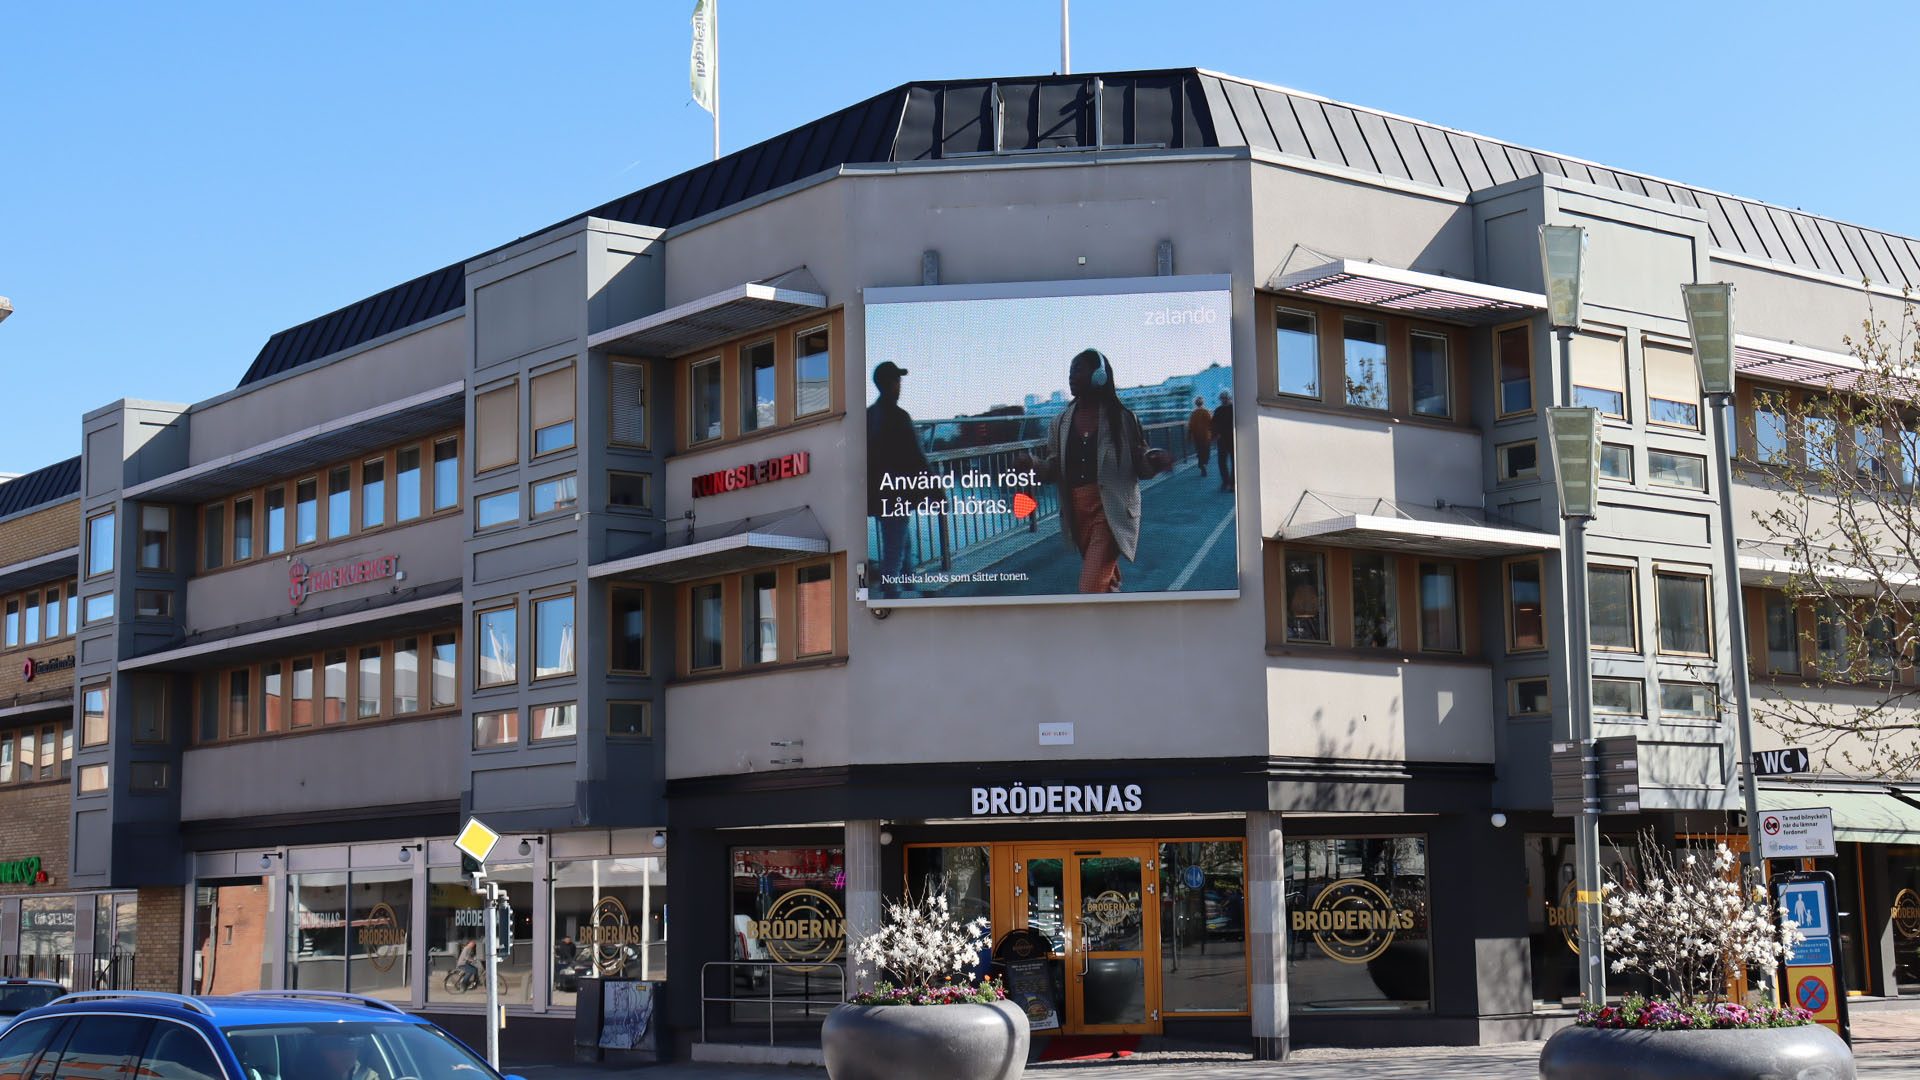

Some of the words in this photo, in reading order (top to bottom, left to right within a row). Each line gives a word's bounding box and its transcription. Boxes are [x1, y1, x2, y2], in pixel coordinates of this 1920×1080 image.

[1144, 307, 1217, 326] zalando
[692, 451, 810, 498] KUNGSLEDEN
[879, 471, 954, 490] Använd
[961, 470, 991, 489] din
[998, 469, 1041, 488] röst.
[881, 497, 912, 517] Låt
[917, 496, 948, 517] det
[952, 494, 1012, 516] höras.
[308, 555, 397, 593] TRAFIKVERKET
[881, 573, 923, 585] Nordiska
[924, 573, 949, 584] looks
[950, 574, 971, 583] som
[971, 571, 998, 583] sätter
[999, 571, 1029, 582] tonen.
[1761, 751, 1792, 774] WC
[971, 782, 1142, 815] BRÖDERNAS
[747, 917, 847, 940] BRÖDERNA
[1292, 907, 1414, 931] BRÖDERNAS
